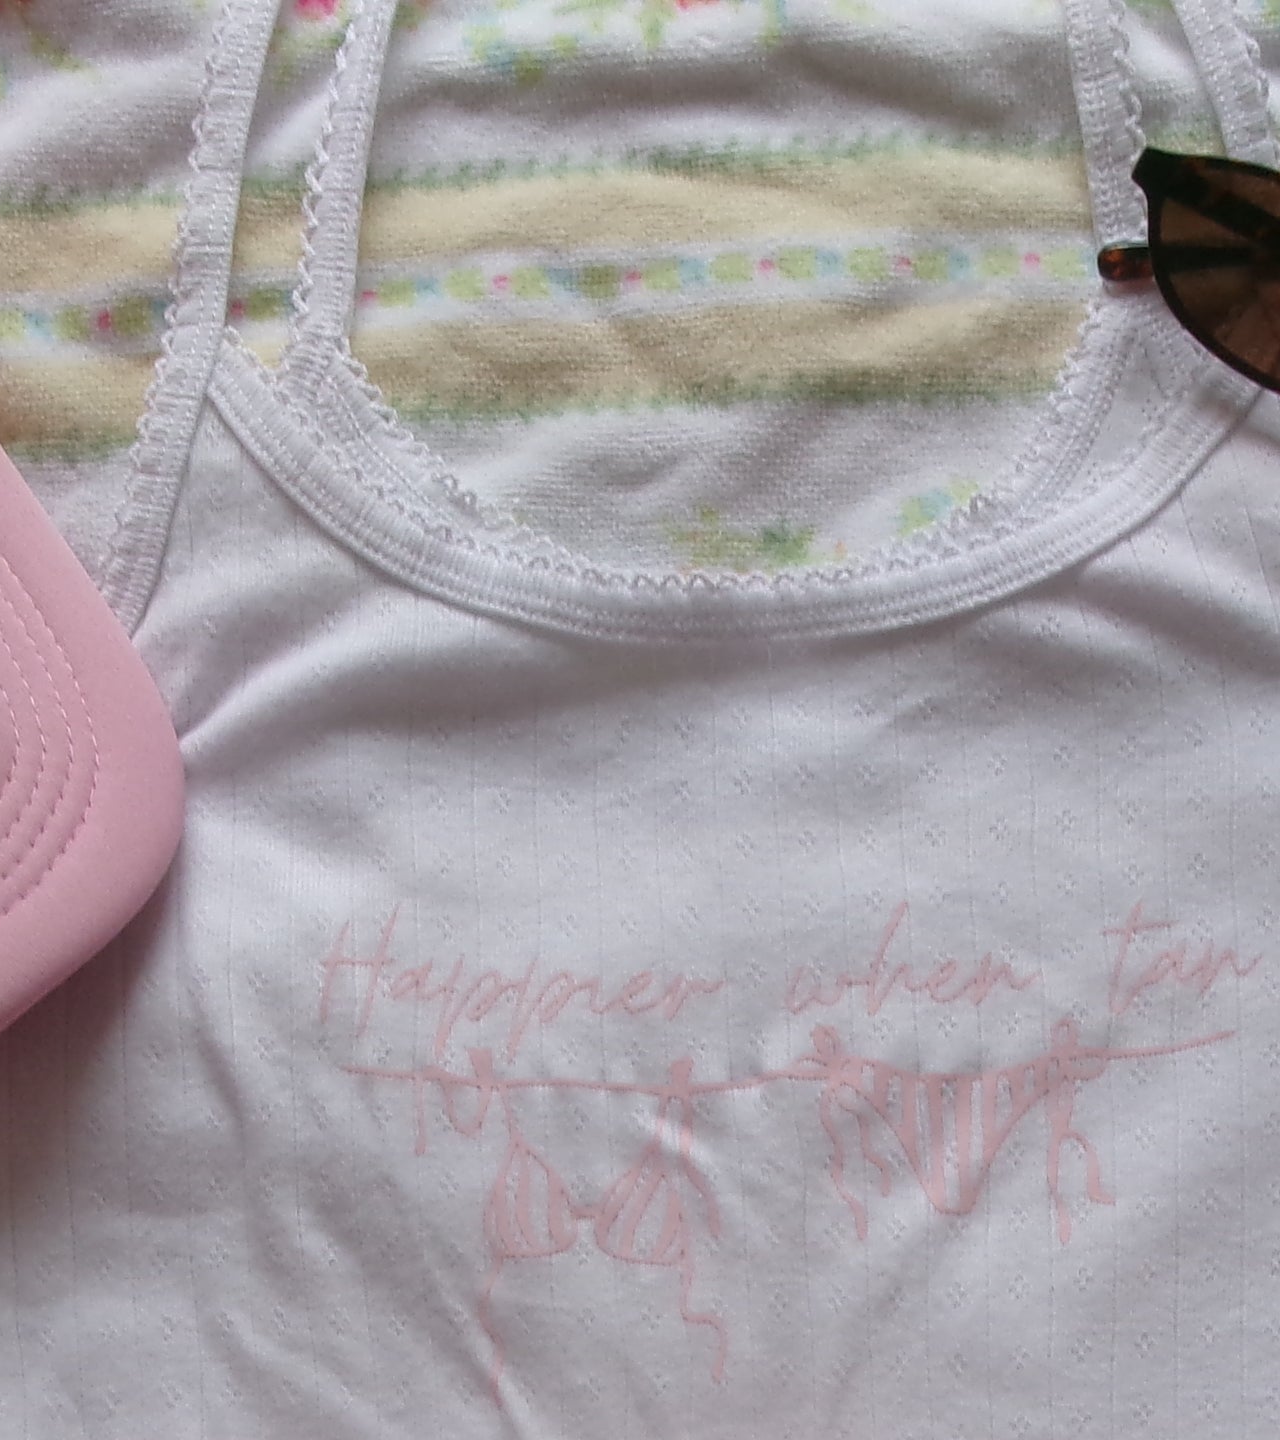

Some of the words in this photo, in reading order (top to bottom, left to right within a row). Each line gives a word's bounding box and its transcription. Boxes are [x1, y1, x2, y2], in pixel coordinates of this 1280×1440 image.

[320, 904, 723, 1064] Happier
[784, 900, 1044, 1016] when
[1102, 900, 1264, 1014] tan
